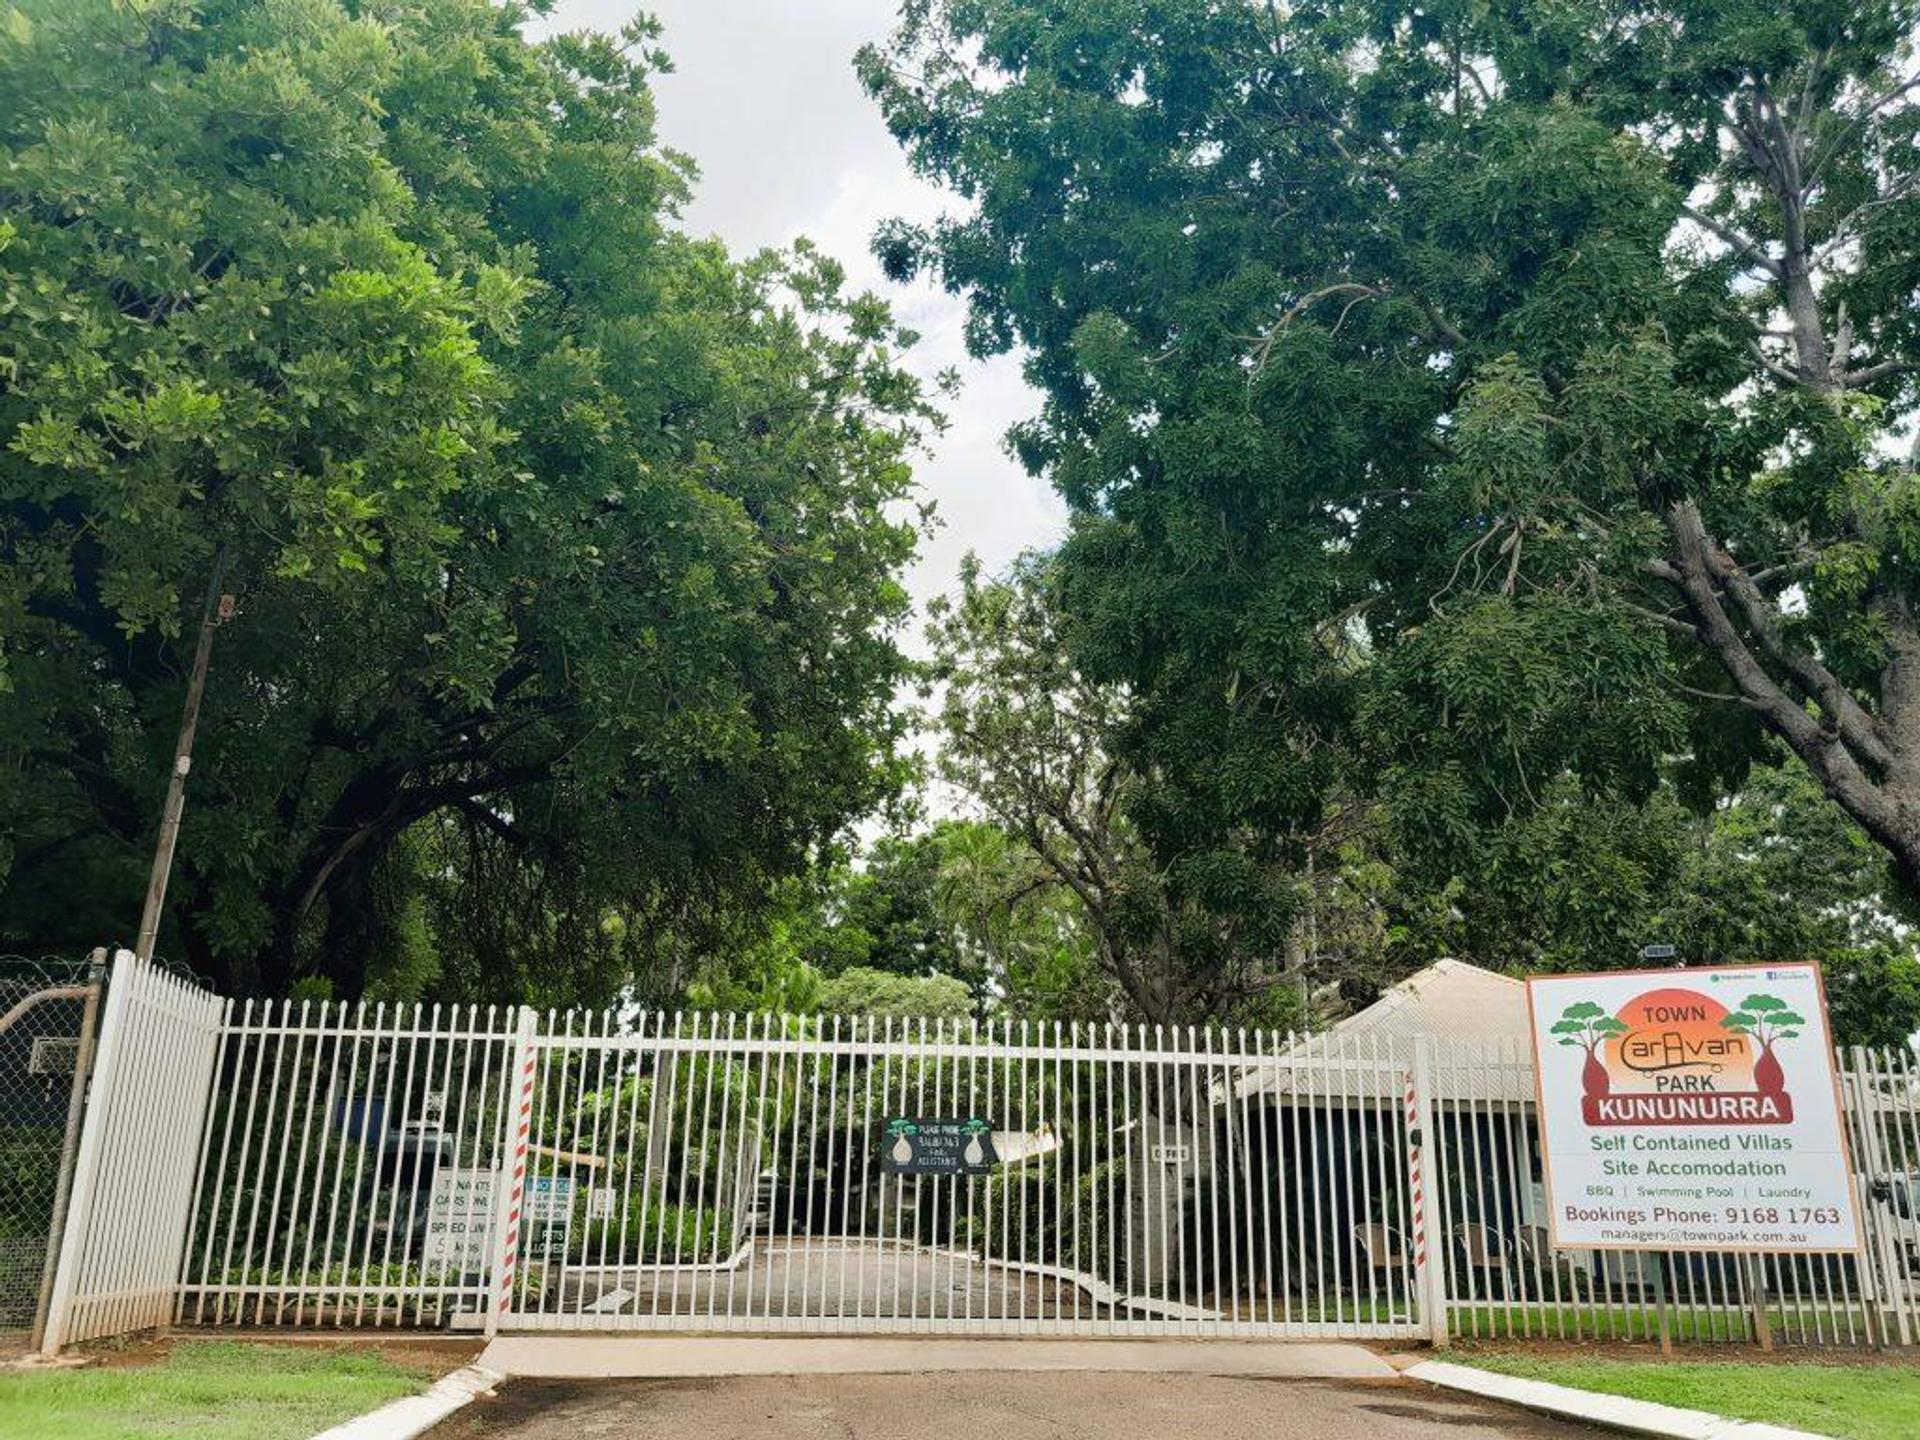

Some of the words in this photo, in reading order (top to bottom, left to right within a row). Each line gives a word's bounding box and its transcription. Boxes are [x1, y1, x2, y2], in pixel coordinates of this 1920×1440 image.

[1643, 1006, 1706, 1022] TOWN
[1656, 1074, 1715, 1092] PARK
[1599, 1096, 1780, 1121] KUNUNURRA
[1590, 1135, 1626, 1151] Self
[1633, 1134, 1731, 1151] Contained
[1737, 1134, 1793, 1150] Villas
[1602, 1160, 1639, 1175] Site
[1646, 1160, 1787, 1176] Accomodation
[1586, 1185, 1615, 1197] BBQ
[1637, 1186, 1702, 1199] Swimming
[1706, 1187, 1734, 1198] Pool
[1758, 1187, 1812, 1199] Laundry
[1565, 1206, 1646, 1224] Bookings
[1653, 1206, 1719, 1223] Phone:
[1725, 1207, 1779, 1224] 9168
[1788, 1208, 1841, 1224] 1763
[1601, 1228, 1807, 1243] managers@townpark.com.au
